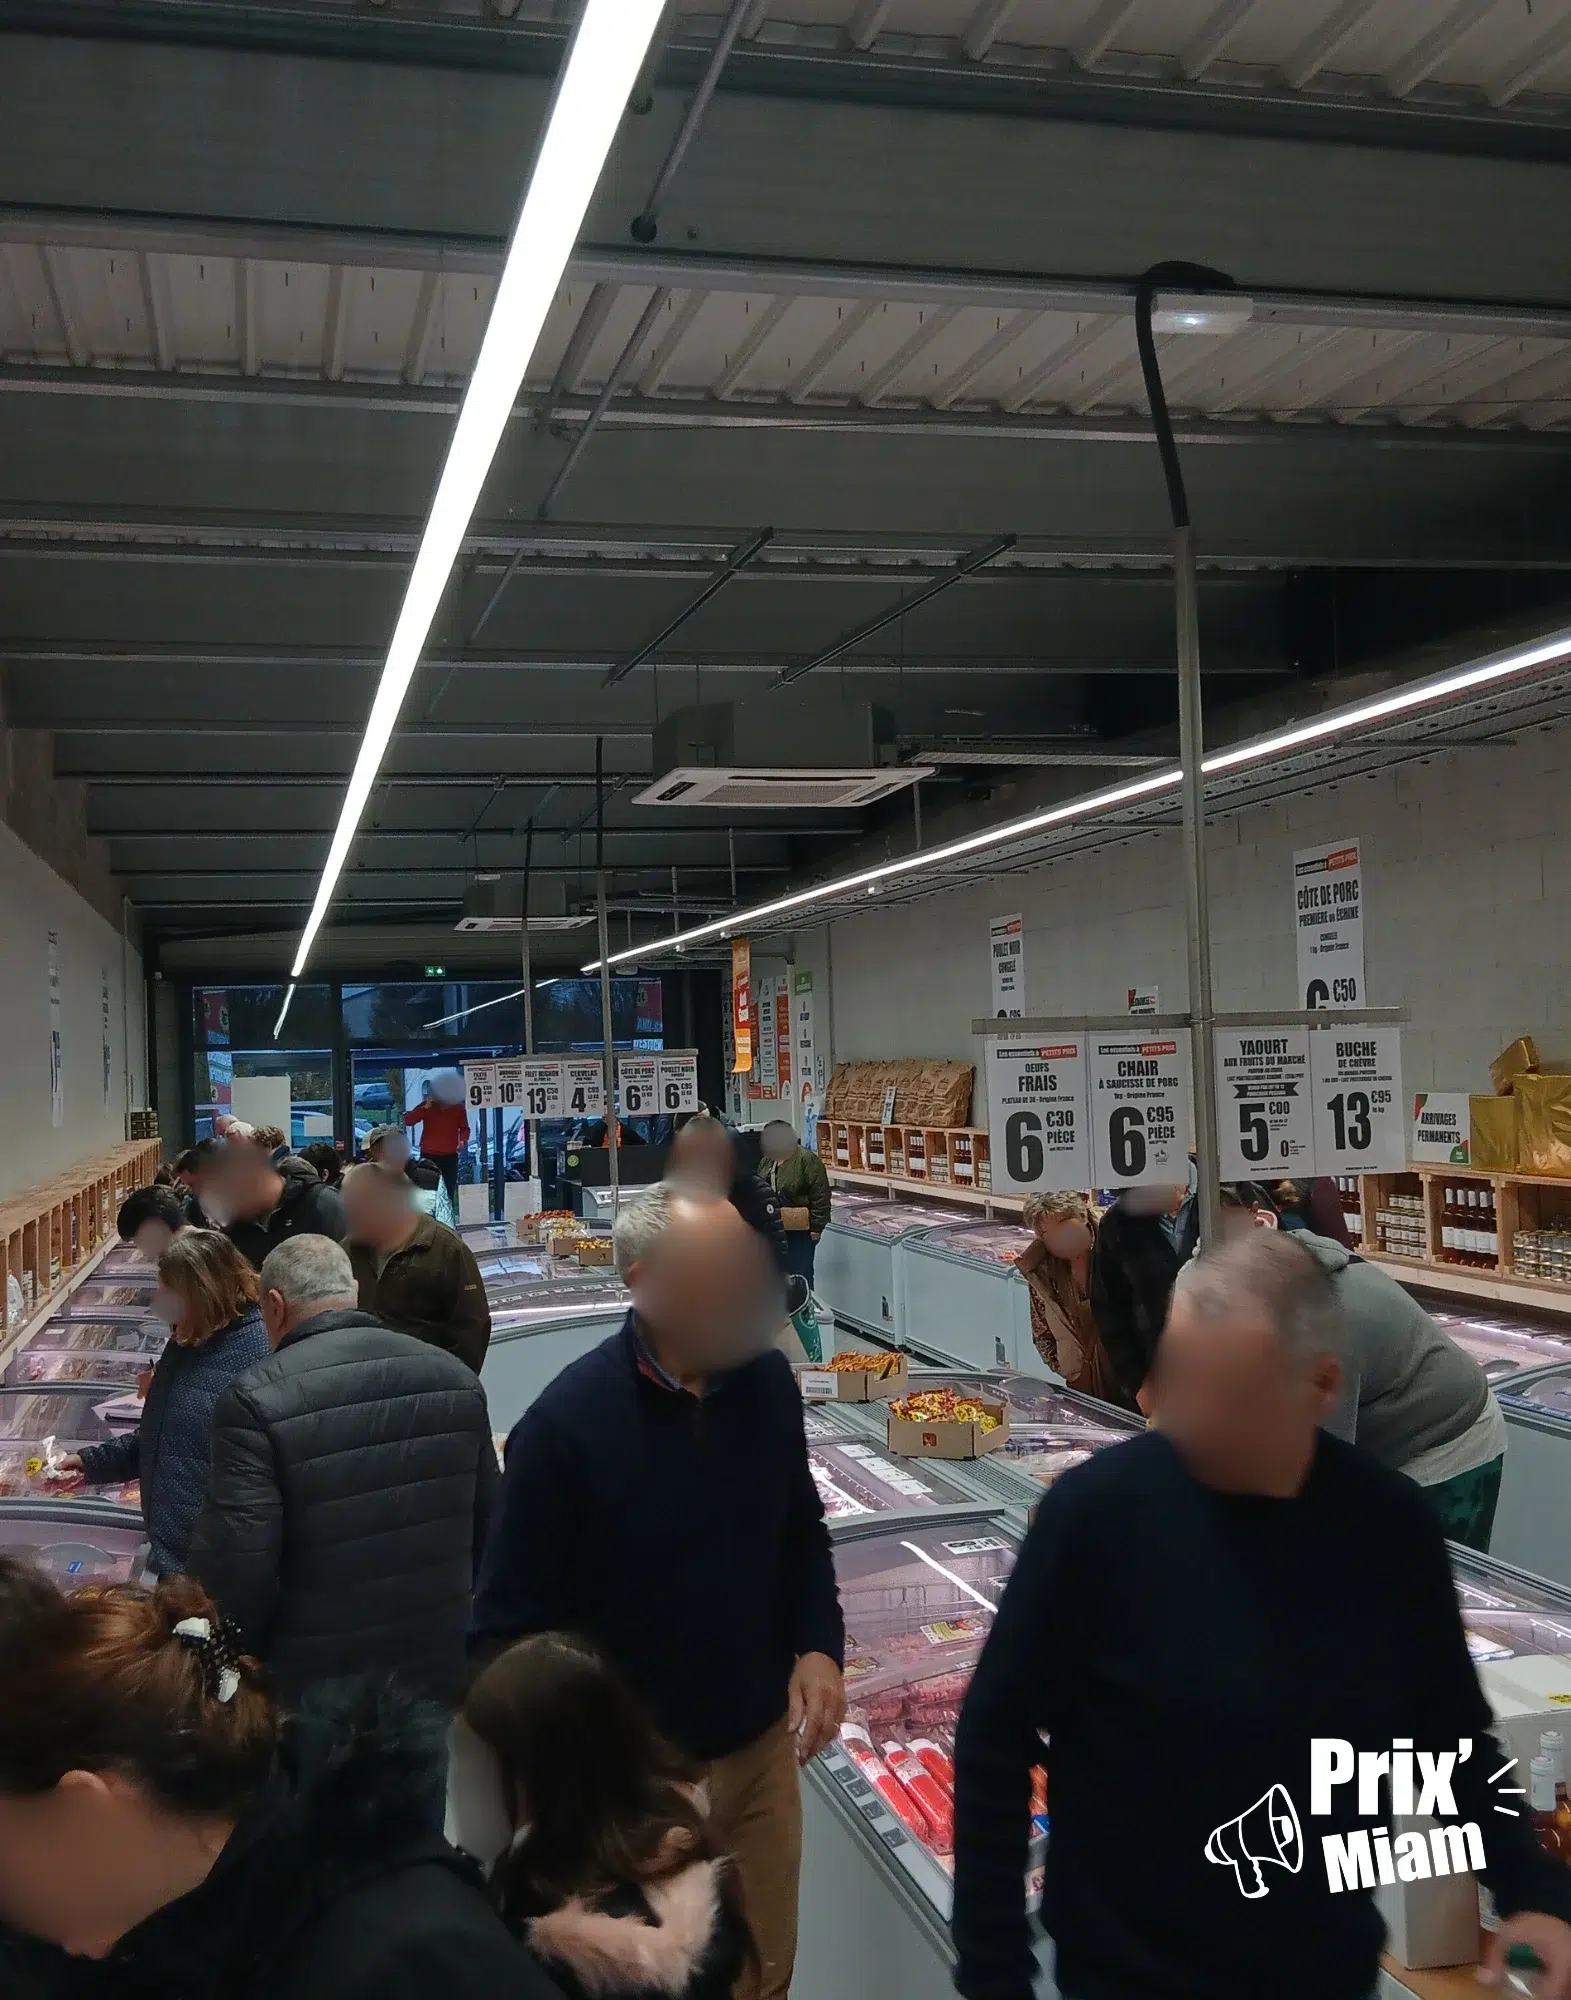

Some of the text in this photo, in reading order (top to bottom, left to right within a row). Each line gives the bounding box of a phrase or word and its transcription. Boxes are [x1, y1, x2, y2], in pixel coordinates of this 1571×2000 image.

[1297, 879, 1359, 910] CÔTE DE PORC
[1333, 977, 1357, 1003] €50
[1062, 1046, 1077, 1055] PRIX
[1239, 1039, 1289, 1056] YAOURT
[1336, 1041, 1377, 1057] BUCHE
[660, 1065, 681, 1073] POULET
[1025, 1062, 1050, 1073] OEUFS
[1117, 1060, 1159, 1077] CHAIR
[1223, 1054, 1306, 1067] AUX FRUITS DU MARCHÉ
[1338, 1057, 1376, 1068] DE CHÈVRE
[570, 1069, 598, 1078] CERVELAS
[1018, 1074, 1058, 1092] FRAIS
[1099, 1076, 1179, 1089] À SAUCISSE DE PORC
[470, 1085, 482, 1106] 9
[498, 1082, 515, 1103] 10
[526, 1087, 547, 1115] 13
[571, 1087, 587, 1113] 4
[626, 1084, 641, 1111] 6
[665, 1082, 681, 1109] 6
[1126, 1091, 1146, 1099] Origine
[1371, 1090, 1392, 1103] €95
[1146, 1105, 1174, 1123] €95
[1268, 1101, 1290, 1115] €00
[1046, 1110, 1074, 1127] €30
[1326, 1091, 1372, 1150] 13
[1420, 1111, 1457, 1126] ARRIVAGES
[1047, 1128, 1075, 1144] PIÈCE
[1147, 1125, 1176, 1139] PIÈCE
[1239, 1102, 1269, 1162] 5
[1417, 1128, 1461, 1144] PERMANENTS
[1005, 1110, 1044, 1183] 6
[1109, 1106, 1147, 1177] 6
[1280, 1140, 1289, 1157] 0
